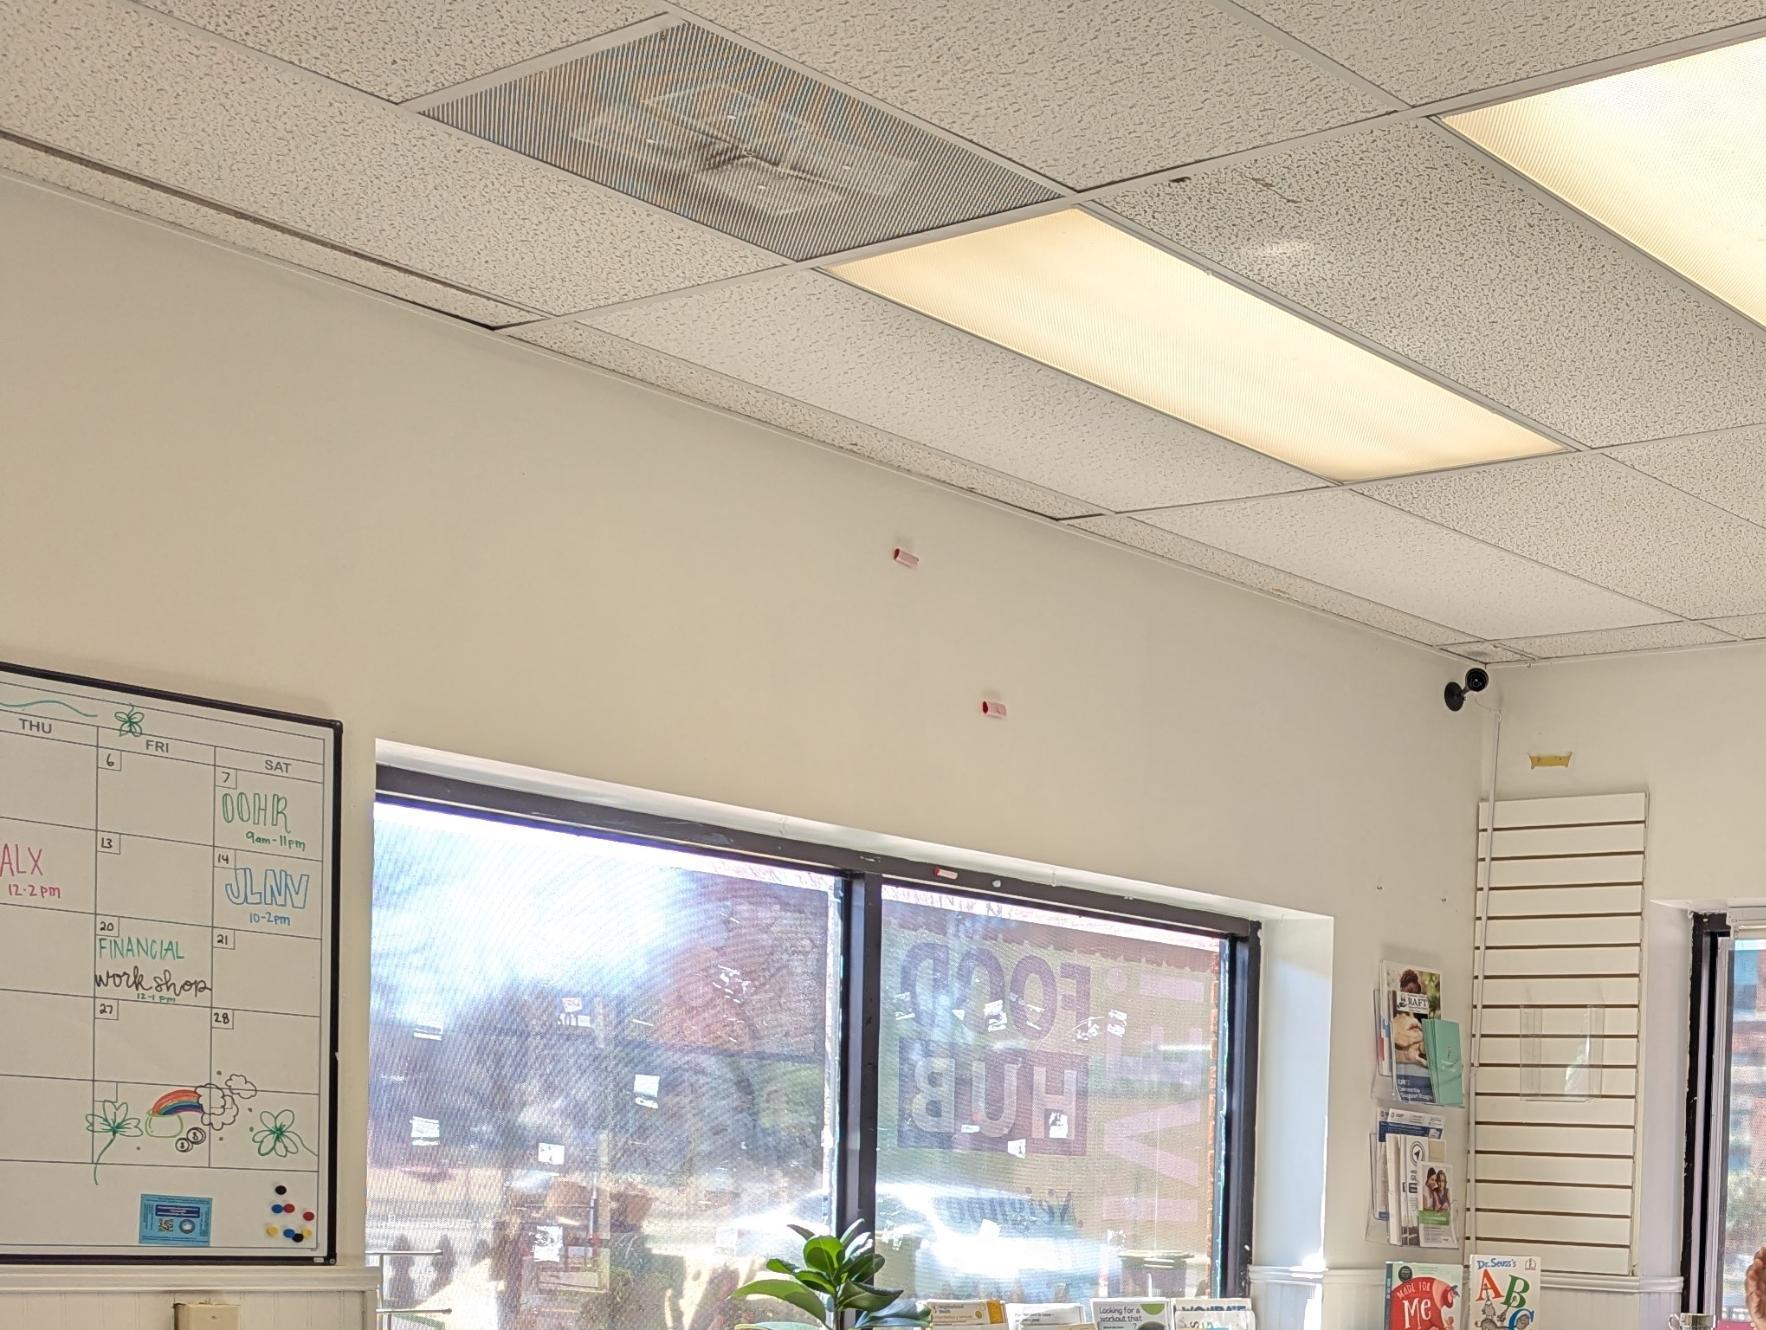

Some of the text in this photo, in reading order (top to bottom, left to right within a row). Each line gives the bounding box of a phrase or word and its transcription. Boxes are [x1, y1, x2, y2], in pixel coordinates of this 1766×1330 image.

[19, 718, 52, 734] THU
[146, 739, 169, 753] FRI
[105, 753, 115, 766] 6
[264, 759, 292, 773] SAT
[222, 772, 231, 783] 7
[101, 837, 113, 849] 13
[217, 853, 229, 865] 14
[100, 921, 114, 932] 20
[217, 934, 228, 945] 21
[98, 936, 184, 960] FINANCIAL
[100, 1003, 113, 1014] 27
[214, 1012, 229, 1024] 28
[1099, 1306, 1123, 1317] Looking
[1123, 1305, 1135, 1315] for
